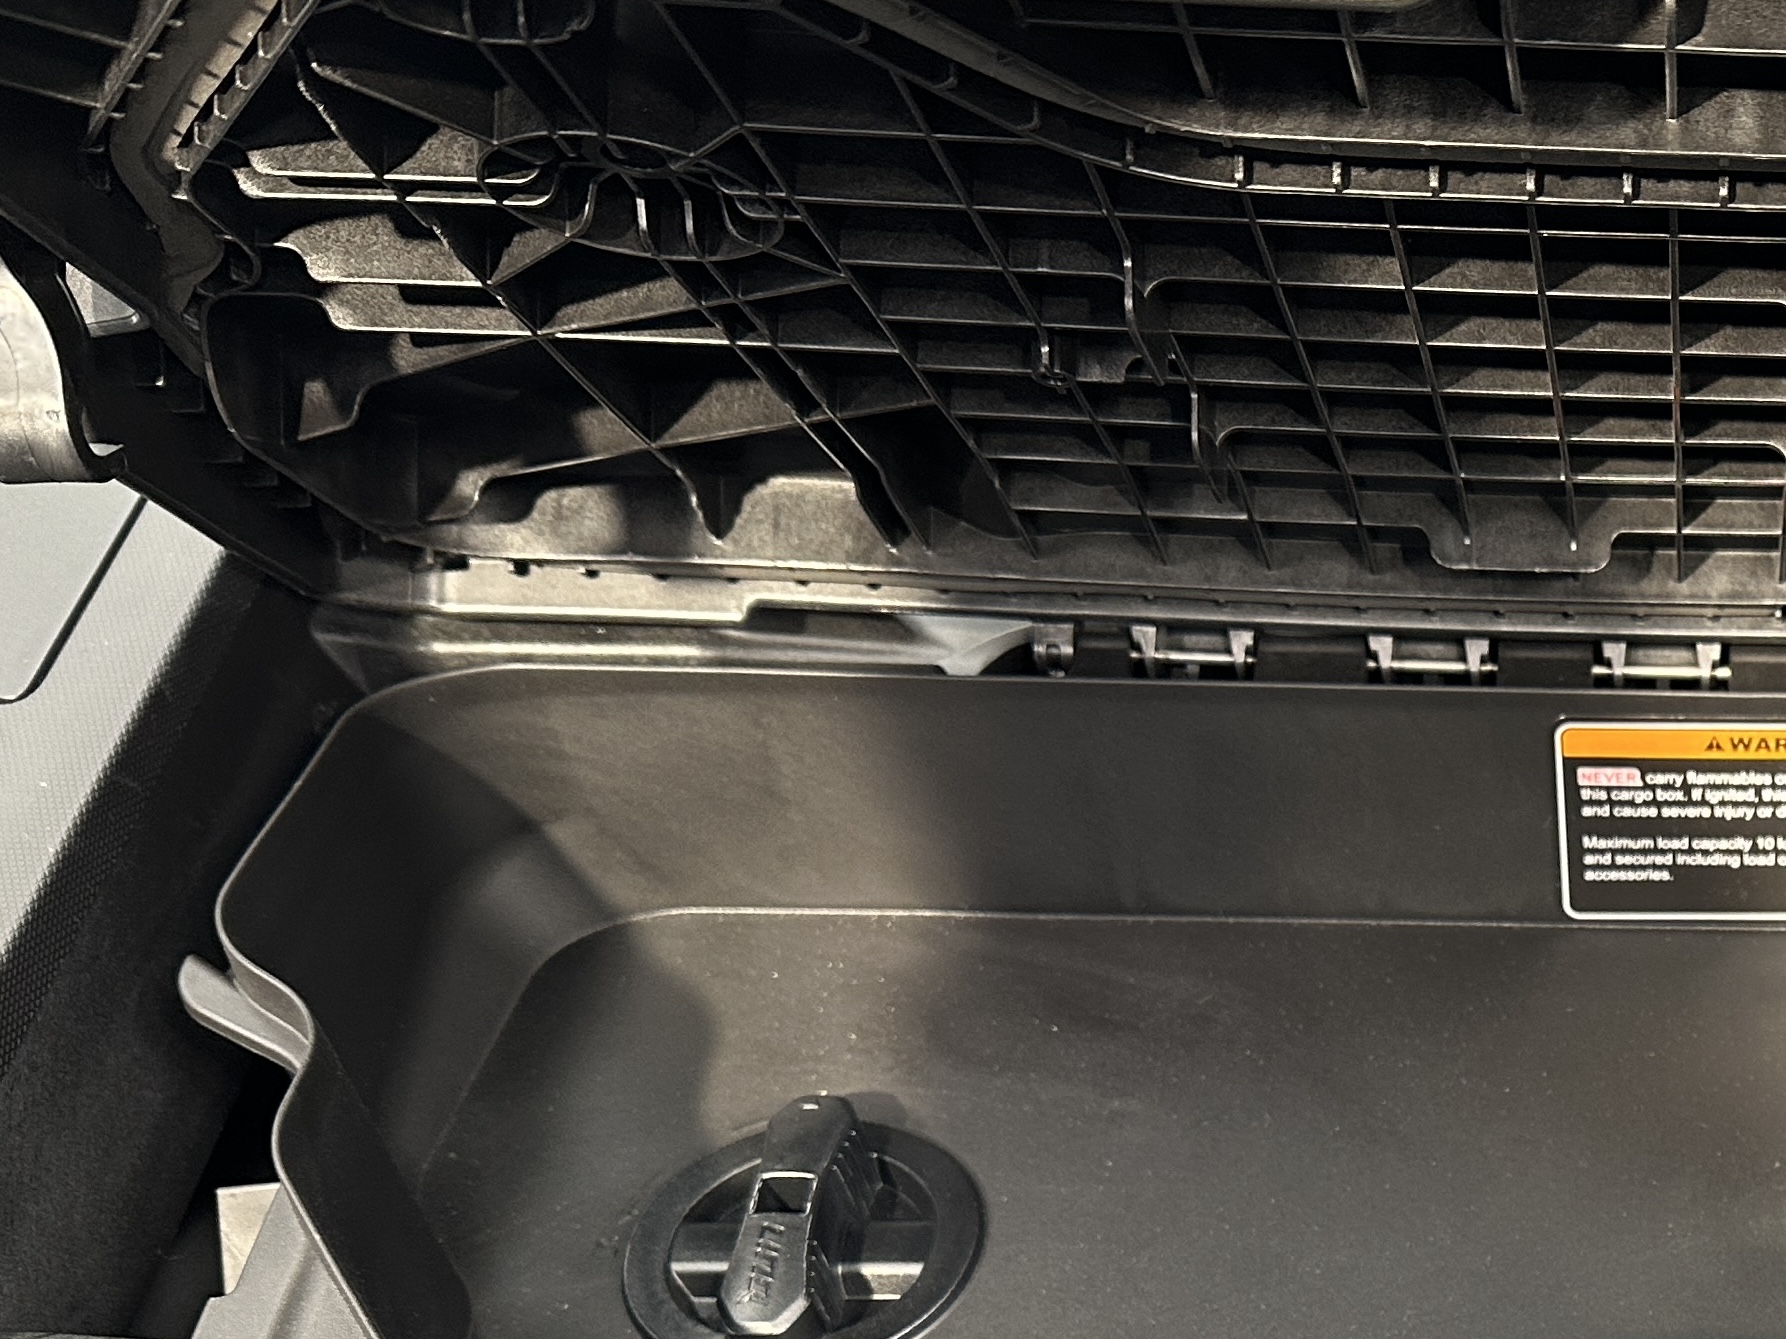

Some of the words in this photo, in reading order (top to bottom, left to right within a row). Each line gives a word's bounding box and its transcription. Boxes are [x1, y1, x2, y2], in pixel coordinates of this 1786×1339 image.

[1580, 771, 1637, 783] NEVER
[1645, 772, 1684, 787] carry
[1579, 788, 1608, 800] this
[1609, 789, 1654, 803] cargo
[1655, 787, 1688, 801] box.
[1580, 804, 1610, 817] and
[1612, 806, 1658, 817] cause
[1660, 806, 1711, 817] severe
[1713, 804, 1755, 821] injury
[1756, 806, 1774, 818] or
[1582, 835, 1654, 849] Maximum
[1656, 836, 1689, 849] load
[1691, 836, 1753, 852] capacity
[1755, 836, 1775, 850] 10
[1583, 852, 1612, 865] and
[1614, 853, 1673, 865] secured
[1675, 852, 1741, 868] including
[1742, 853, 1775, 866] load
[1583, 869, 1674, 881] accessories.
